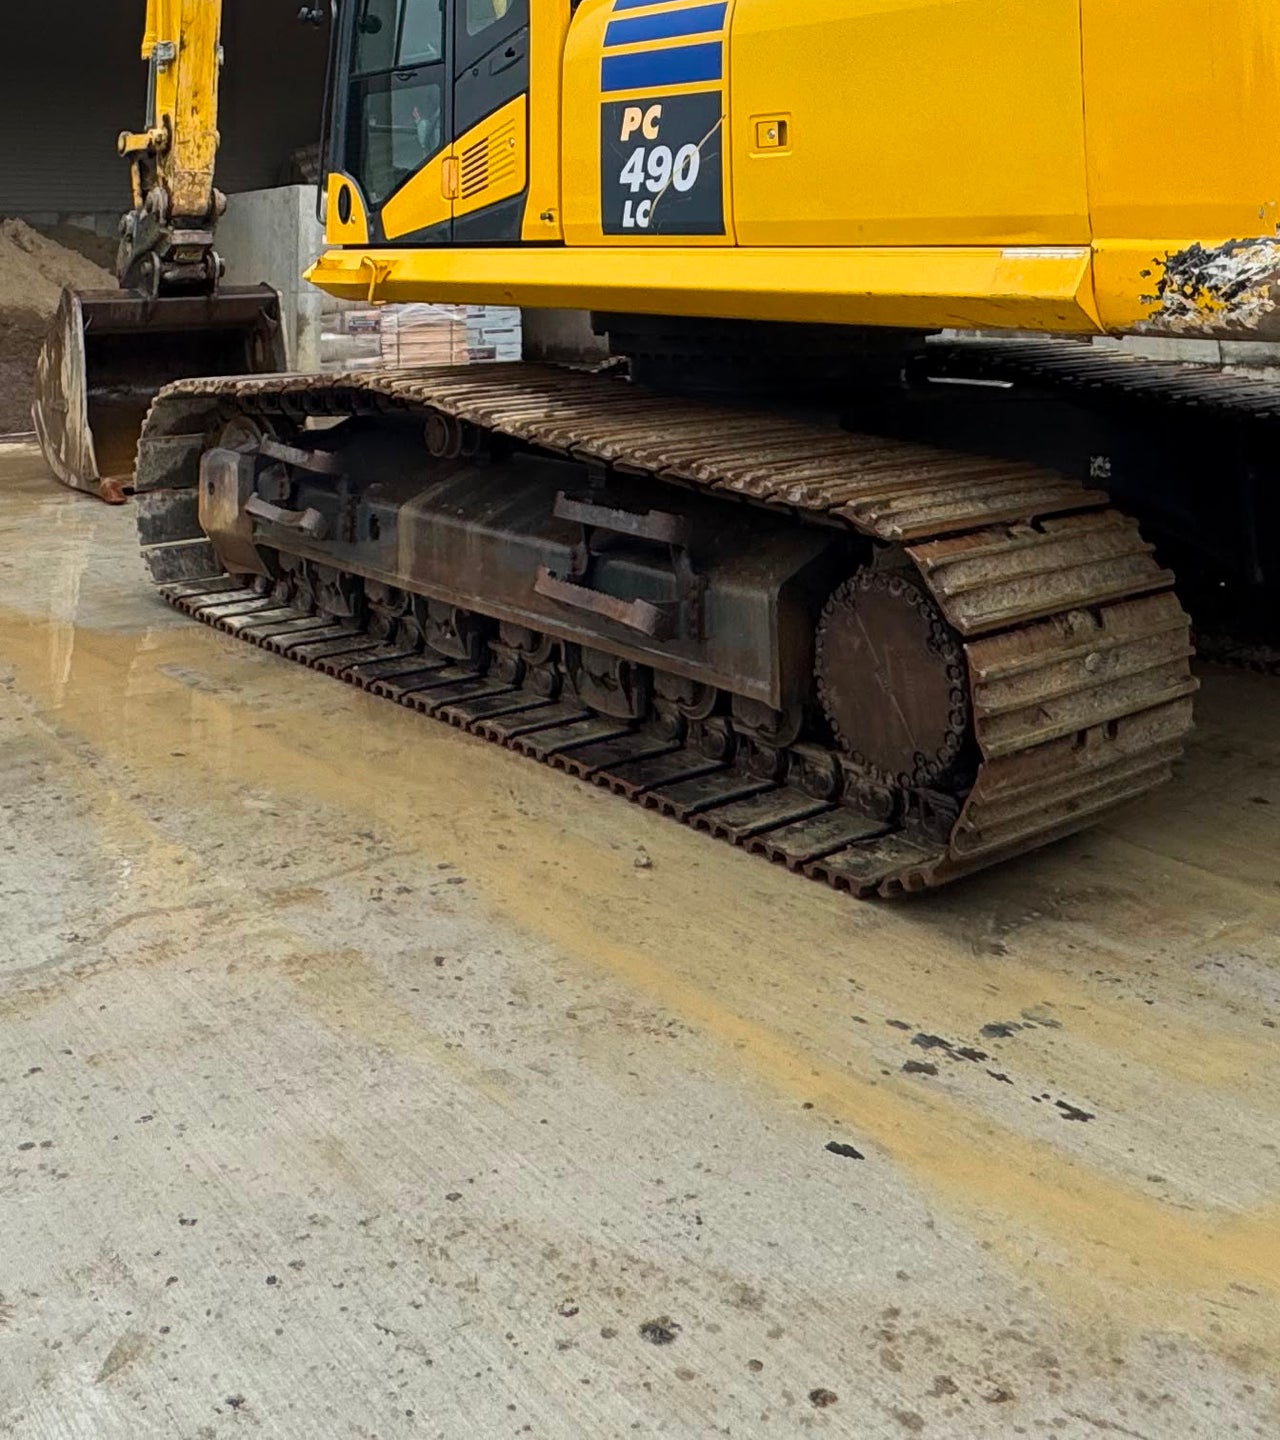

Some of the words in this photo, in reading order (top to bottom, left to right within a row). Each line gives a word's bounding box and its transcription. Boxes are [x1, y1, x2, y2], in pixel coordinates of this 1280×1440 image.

[620, 104, 662, 142] PC
[619, 143, 700, 193] 490
[622, 199, 652, 228] LC
